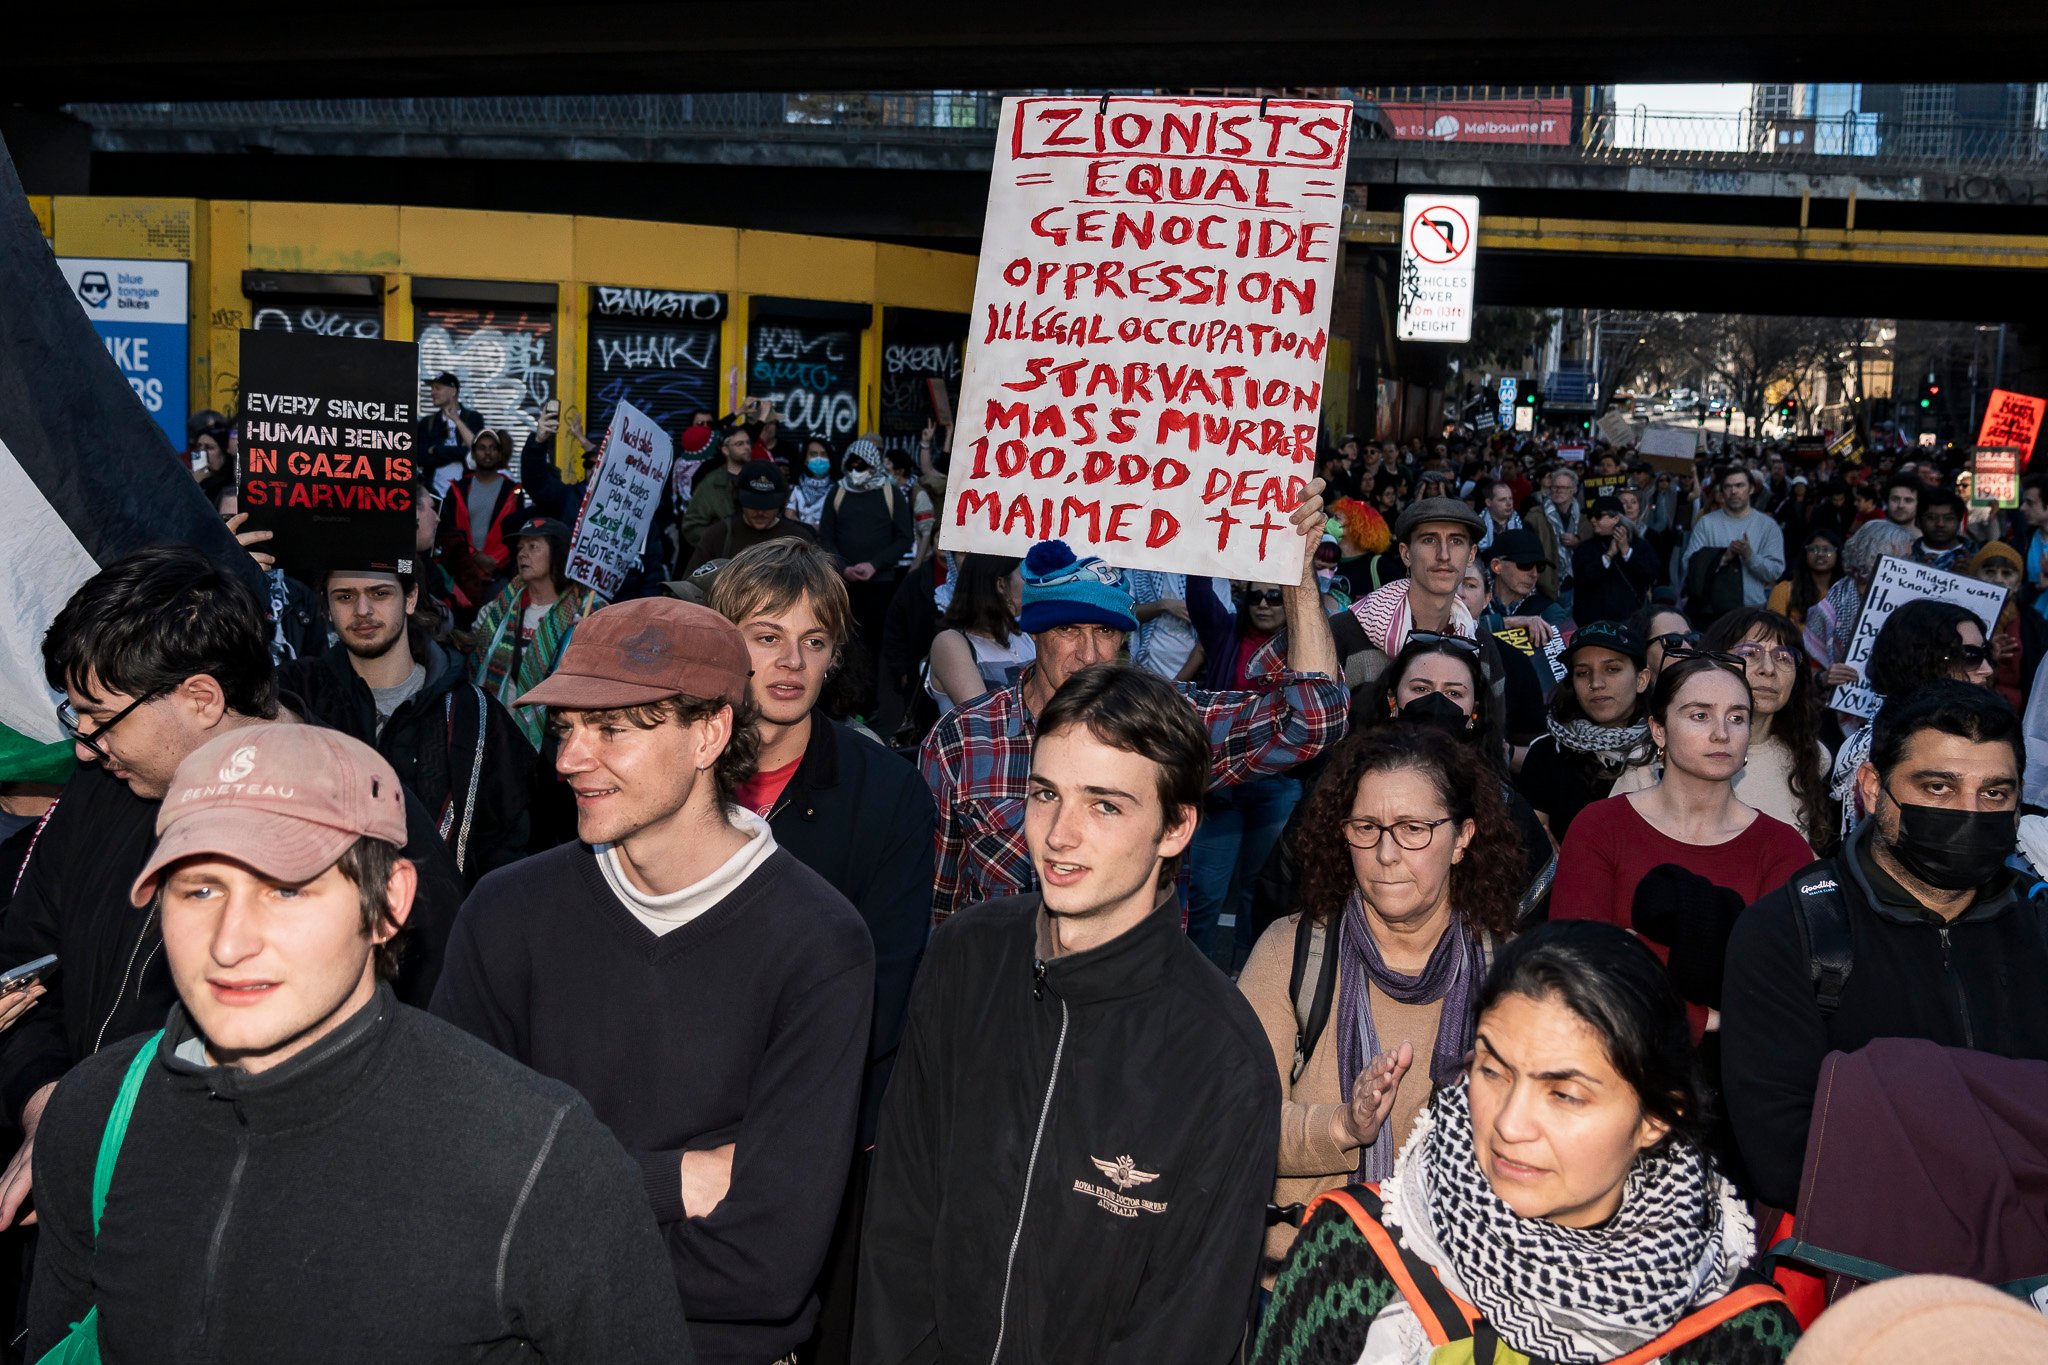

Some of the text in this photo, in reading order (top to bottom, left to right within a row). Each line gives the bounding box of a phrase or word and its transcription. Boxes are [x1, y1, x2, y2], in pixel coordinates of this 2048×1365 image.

[1036, 107, 1341, 160] ZIONISTS
[1087, 160, 1293, 208] EQUAL
[1031, 207, 1334, 262] GENOCIDE
[117, 273, 143, 285] blue
[118, 286, 160, 298] tongue
[1003, 258, 1317, 315] OPPRESSION
[117, 298, 150, 310] bikes
[1420, 291, 1452, 302] OVER
[985, 302, 1326, 364] ILLEGAL OCCUPATION
[1412, 321, 1456, 331] HEIGHT
[1002, 356, 1320, 412] STARVATION
[247, 393, 409, 423] EVERY SINGLE
[247, 421, 412, 451] HUMAN BEING
[985, 398, 1141, 446] MASS
[1156, 407, 1317, 464] MURDER
[249, 448, 412, 482] IN GAZA IS
[246, 480, 411, 511] STARVING
[605, 462, 650, 500] Aussie leaders
[1201, 468, 1307, 513] DEAD
[1977, 487, 2012, 498] 1948
[605, 488, 624, 512] play
[588, 502, 624, 532] Zionist
[957, 489, 1182, 549] MAIMED
[577, 536, 600, 558] END
[599, 546, 615, 565] THE
[568, 554, 593, 580] FREE
[1880, 572, 1892, 584] to
[1883, 558, 2001, 601] This Midwife wants
[181, 783, 295, 803] BENETEAU
[1801, 880, 1839, 893] Goodlife
[1074, 1180, 1095, 1193] ROYAL
[1116, 1194, 1140, 1207] DOCTOR
[1098, 1199, 1138, 1217] AUSTRALIA
